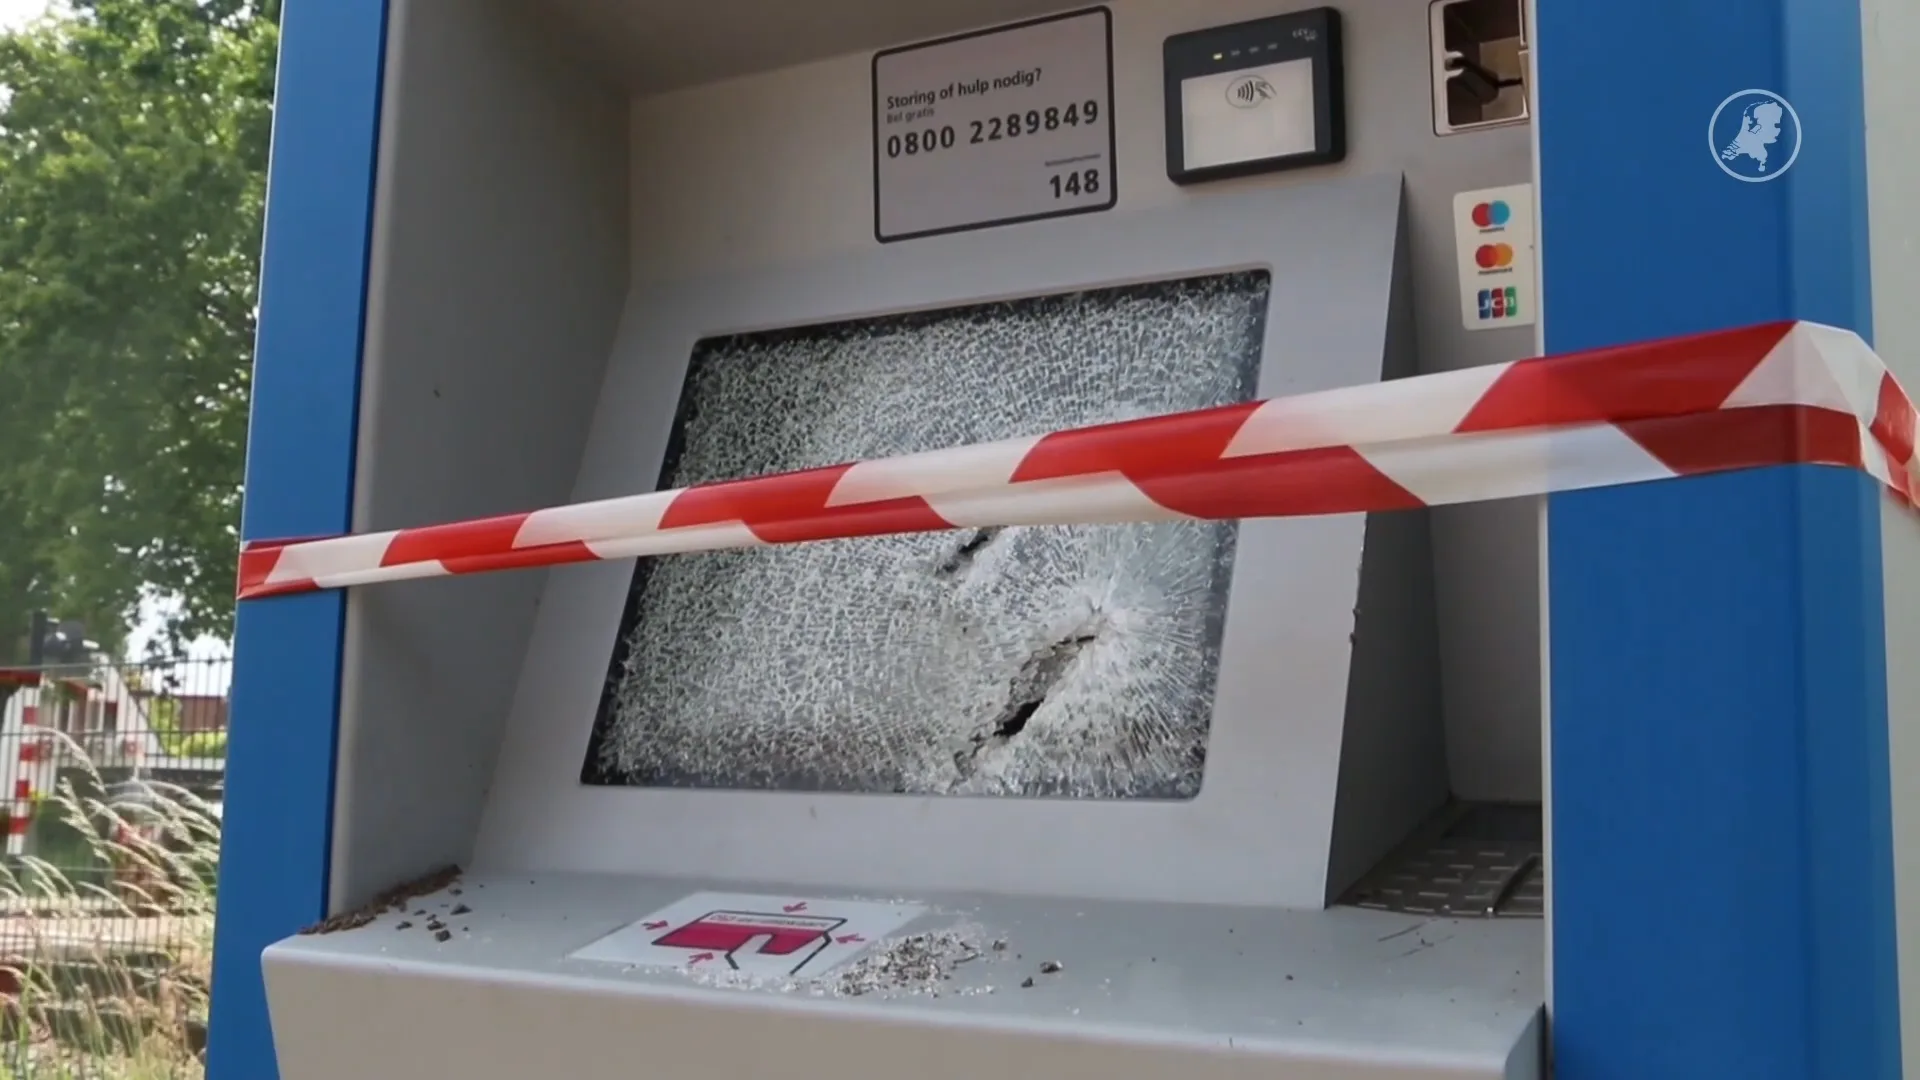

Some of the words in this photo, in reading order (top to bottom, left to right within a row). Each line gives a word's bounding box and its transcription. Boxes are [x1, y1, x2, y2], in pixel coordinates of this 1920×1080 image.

[887, 90, 935, 109] Storing
[939, 83, 954, 99] of
[958, 79, 989, 96] hulp
[993, 68, 1042, 90] nodig?
[887, 126, 955, 158] 0800
[969, 99, 1098, 144] 2289849
[905, 107, 935, 123] gratis
[1049, 168, 1100, 199] 148
[1478, 293, 1517, 313] JCB
